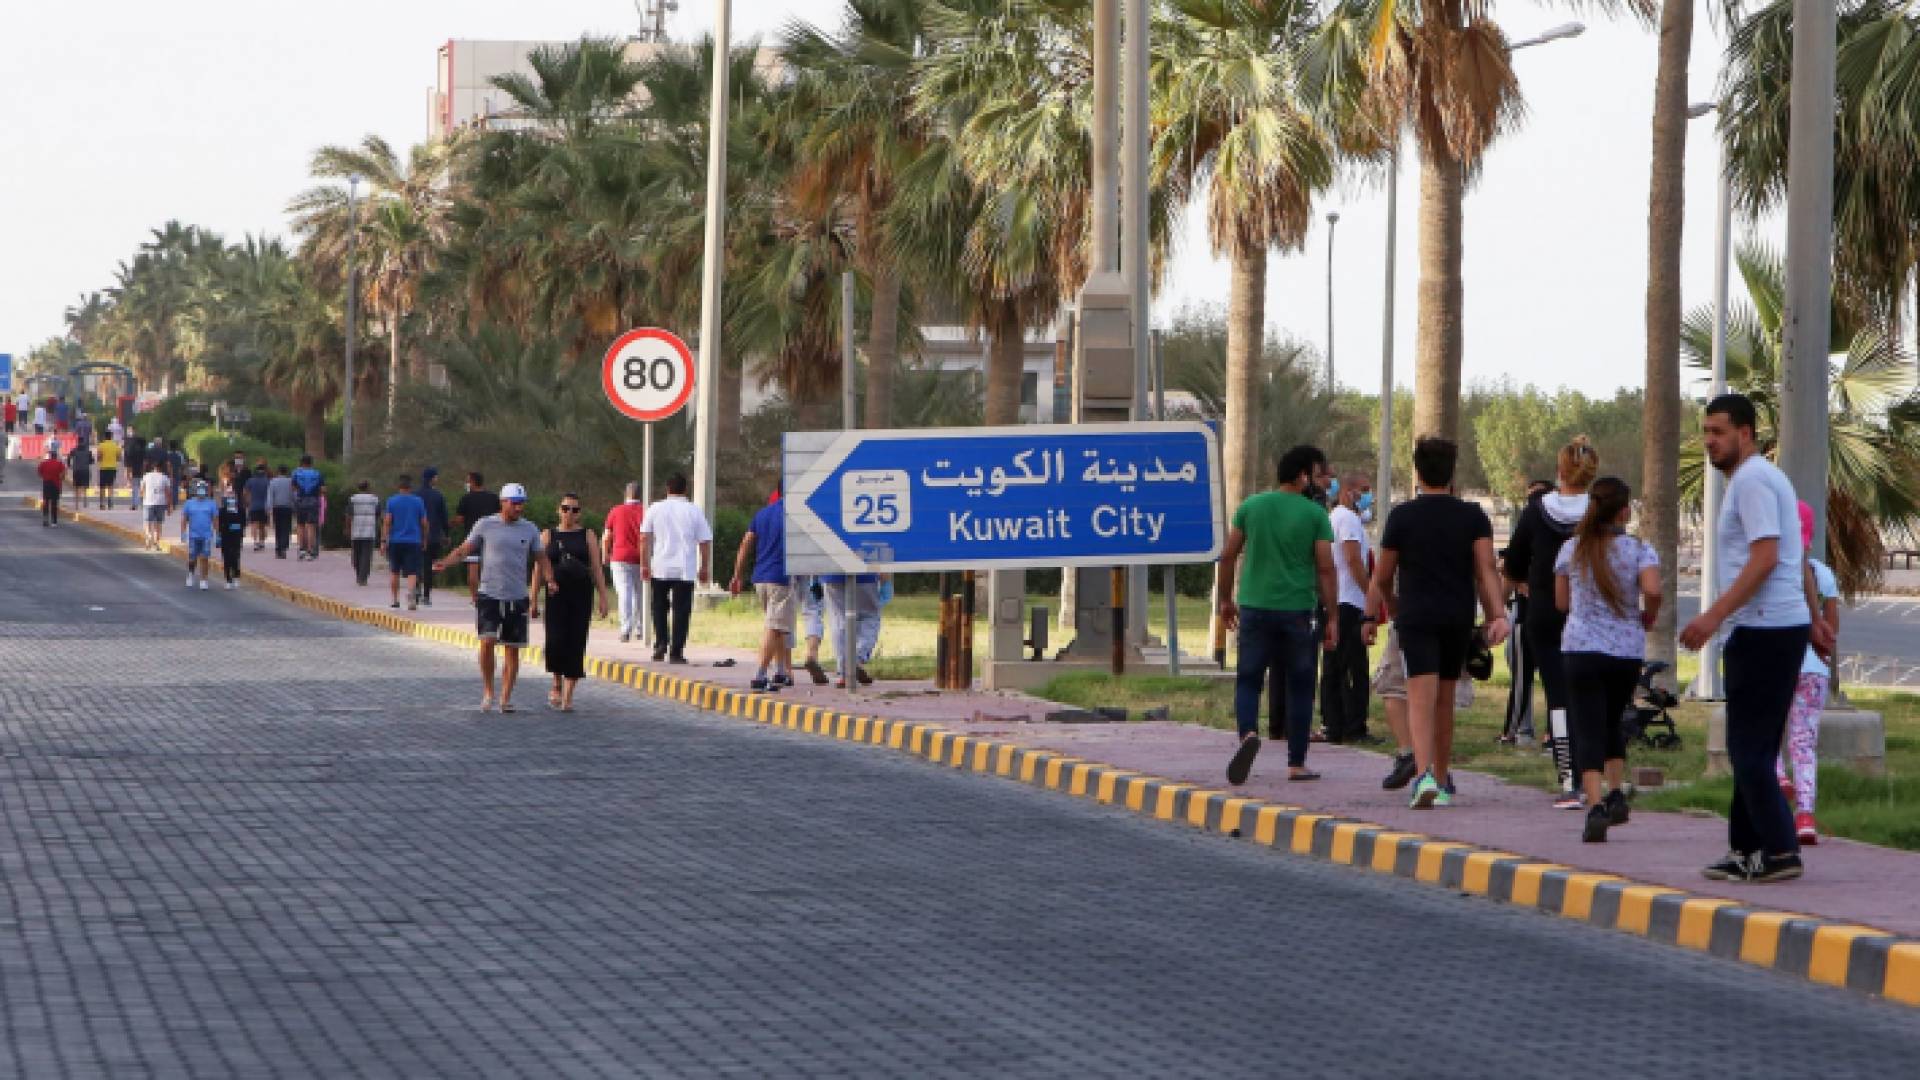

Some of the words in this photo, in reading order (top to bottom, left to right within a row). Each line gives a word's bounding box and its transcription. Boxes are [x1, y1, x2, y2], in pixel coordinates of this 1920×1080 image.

[624, 356, 676, 391] 80
[922, 447, 1066, 497] الكويت
[1082, 449, 1197, 493] مدينة
[855, 494, 898, 525] 25
[949, 508, 1072, 541] Kuwait
[1091, 504, 1166, 542] City
